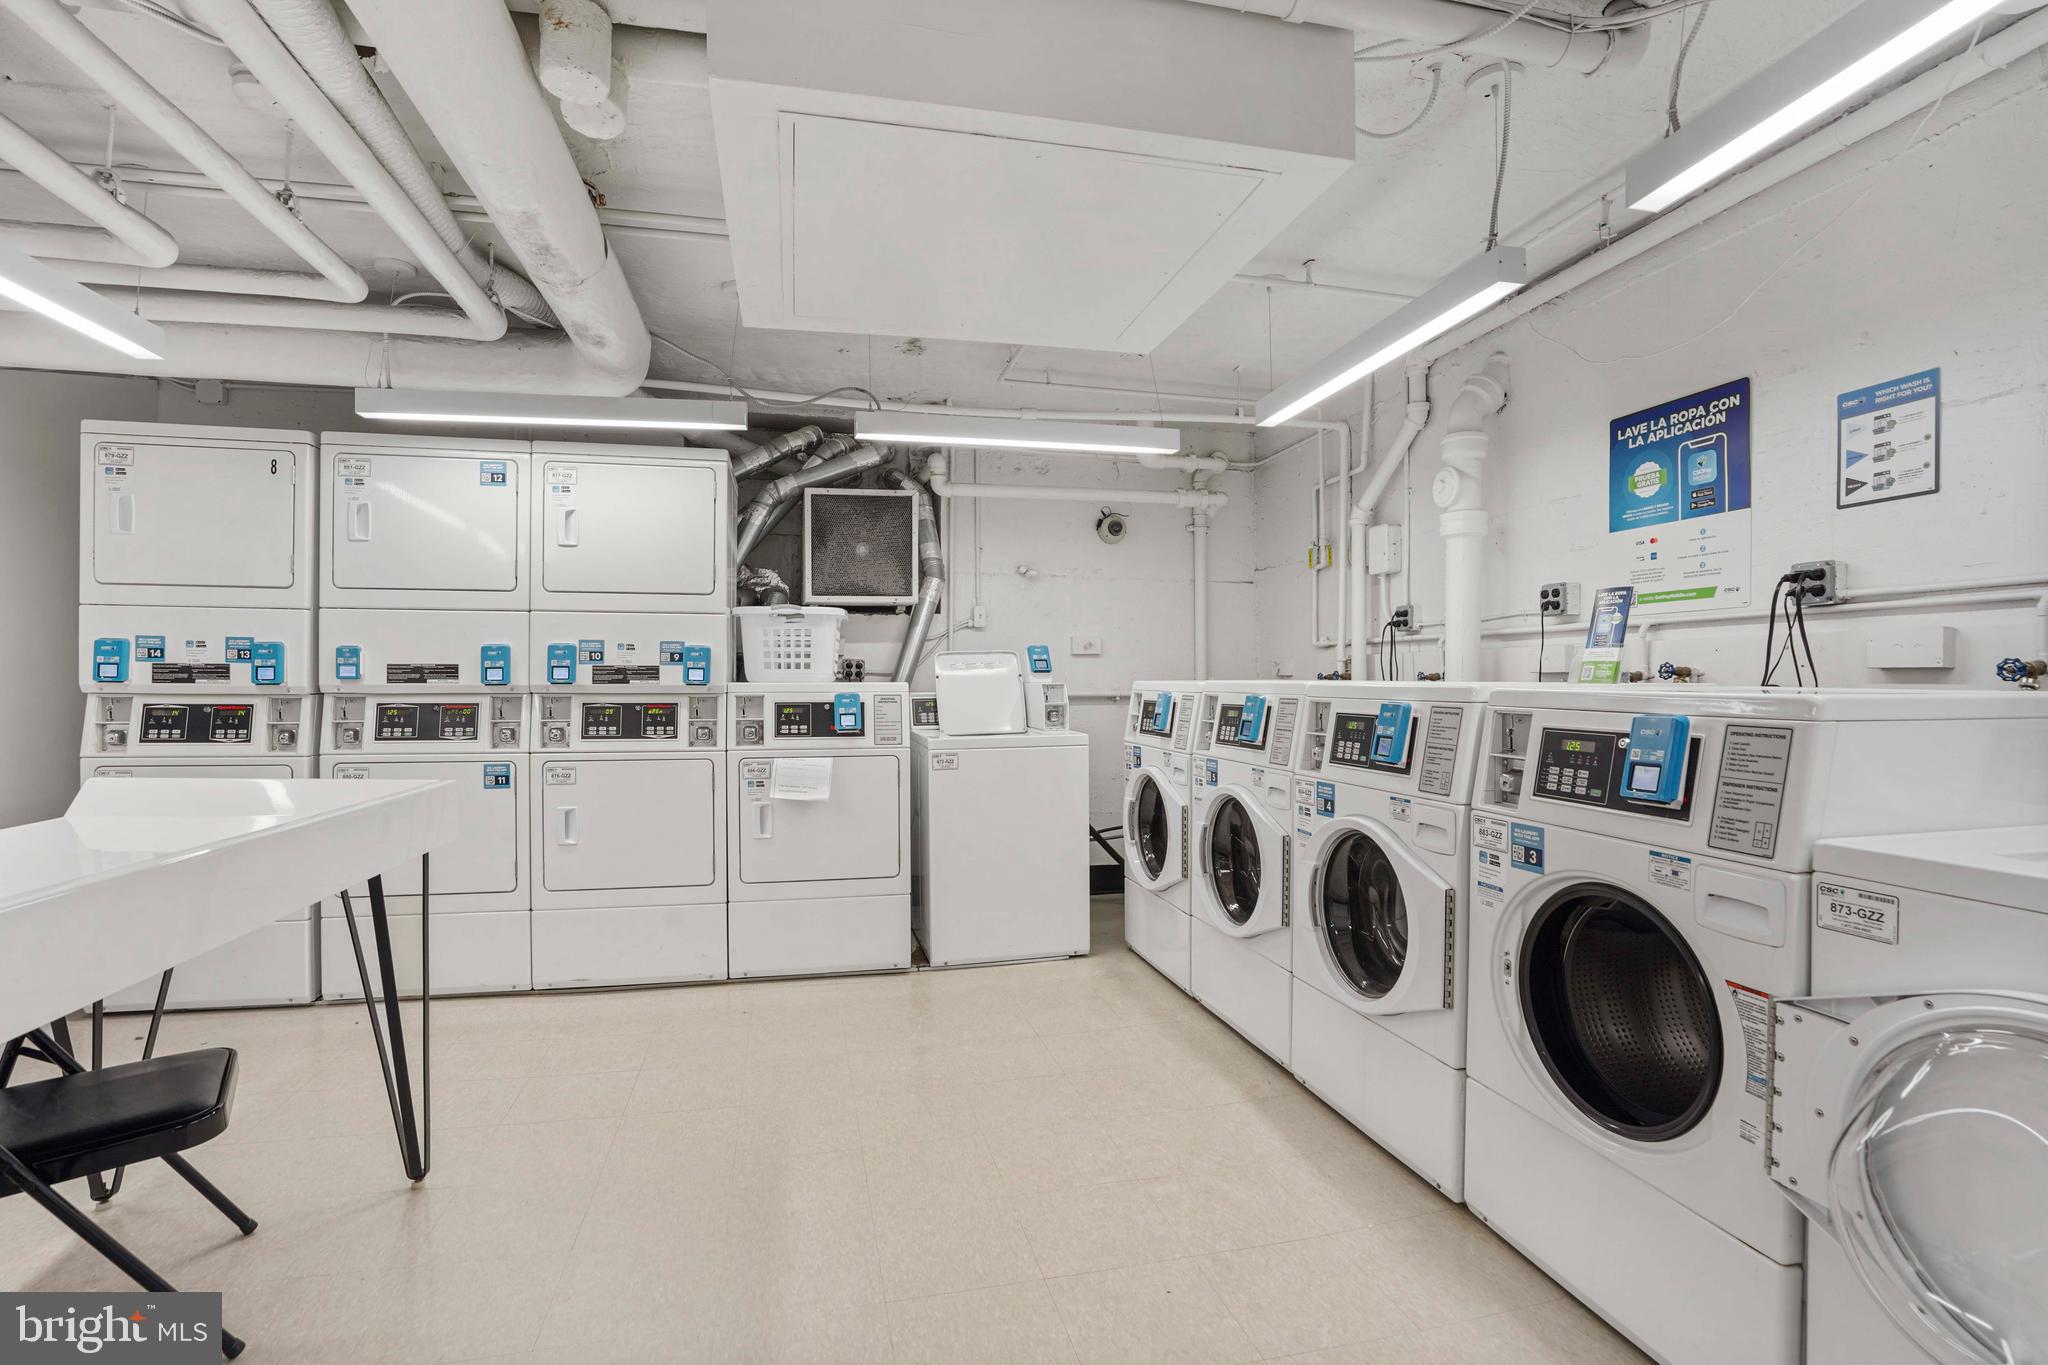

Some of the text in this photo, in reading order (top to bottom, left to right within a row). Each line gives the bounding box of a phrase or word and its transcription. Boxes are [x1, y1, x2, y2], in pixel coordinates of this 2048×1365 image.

[1875, 385, 1899, 398] WHICH
[1901, 380, 1922, 390] WASH
[1875, 384, 1934, 404] RIGHT FOR YOU?
[1617, 394, 1740, 440] LAVE LA ROPA CON
[1628, 411, 1726, 449] LA APLICACIÓN
[270, 459, 278, 474] 8
[493, 474, 503, 482] 12
[1634, 471, 1660, 483] PRUEBA
[1636, 478, 1661, 488] GRATIS
[150, 649, 161, 657] 14
[239, 651, 250, 659] 13
[1212, 773, 1216, 782] 5
[1326, 801, 1332, 812] 4
[1479, 828, 1503, 840] 883-GZZ
[1529, 850, 1537, 864] 3
[1819, 885, 1840, 895] CSC
[1829, 902, 1886, 923] 873-GZZ
